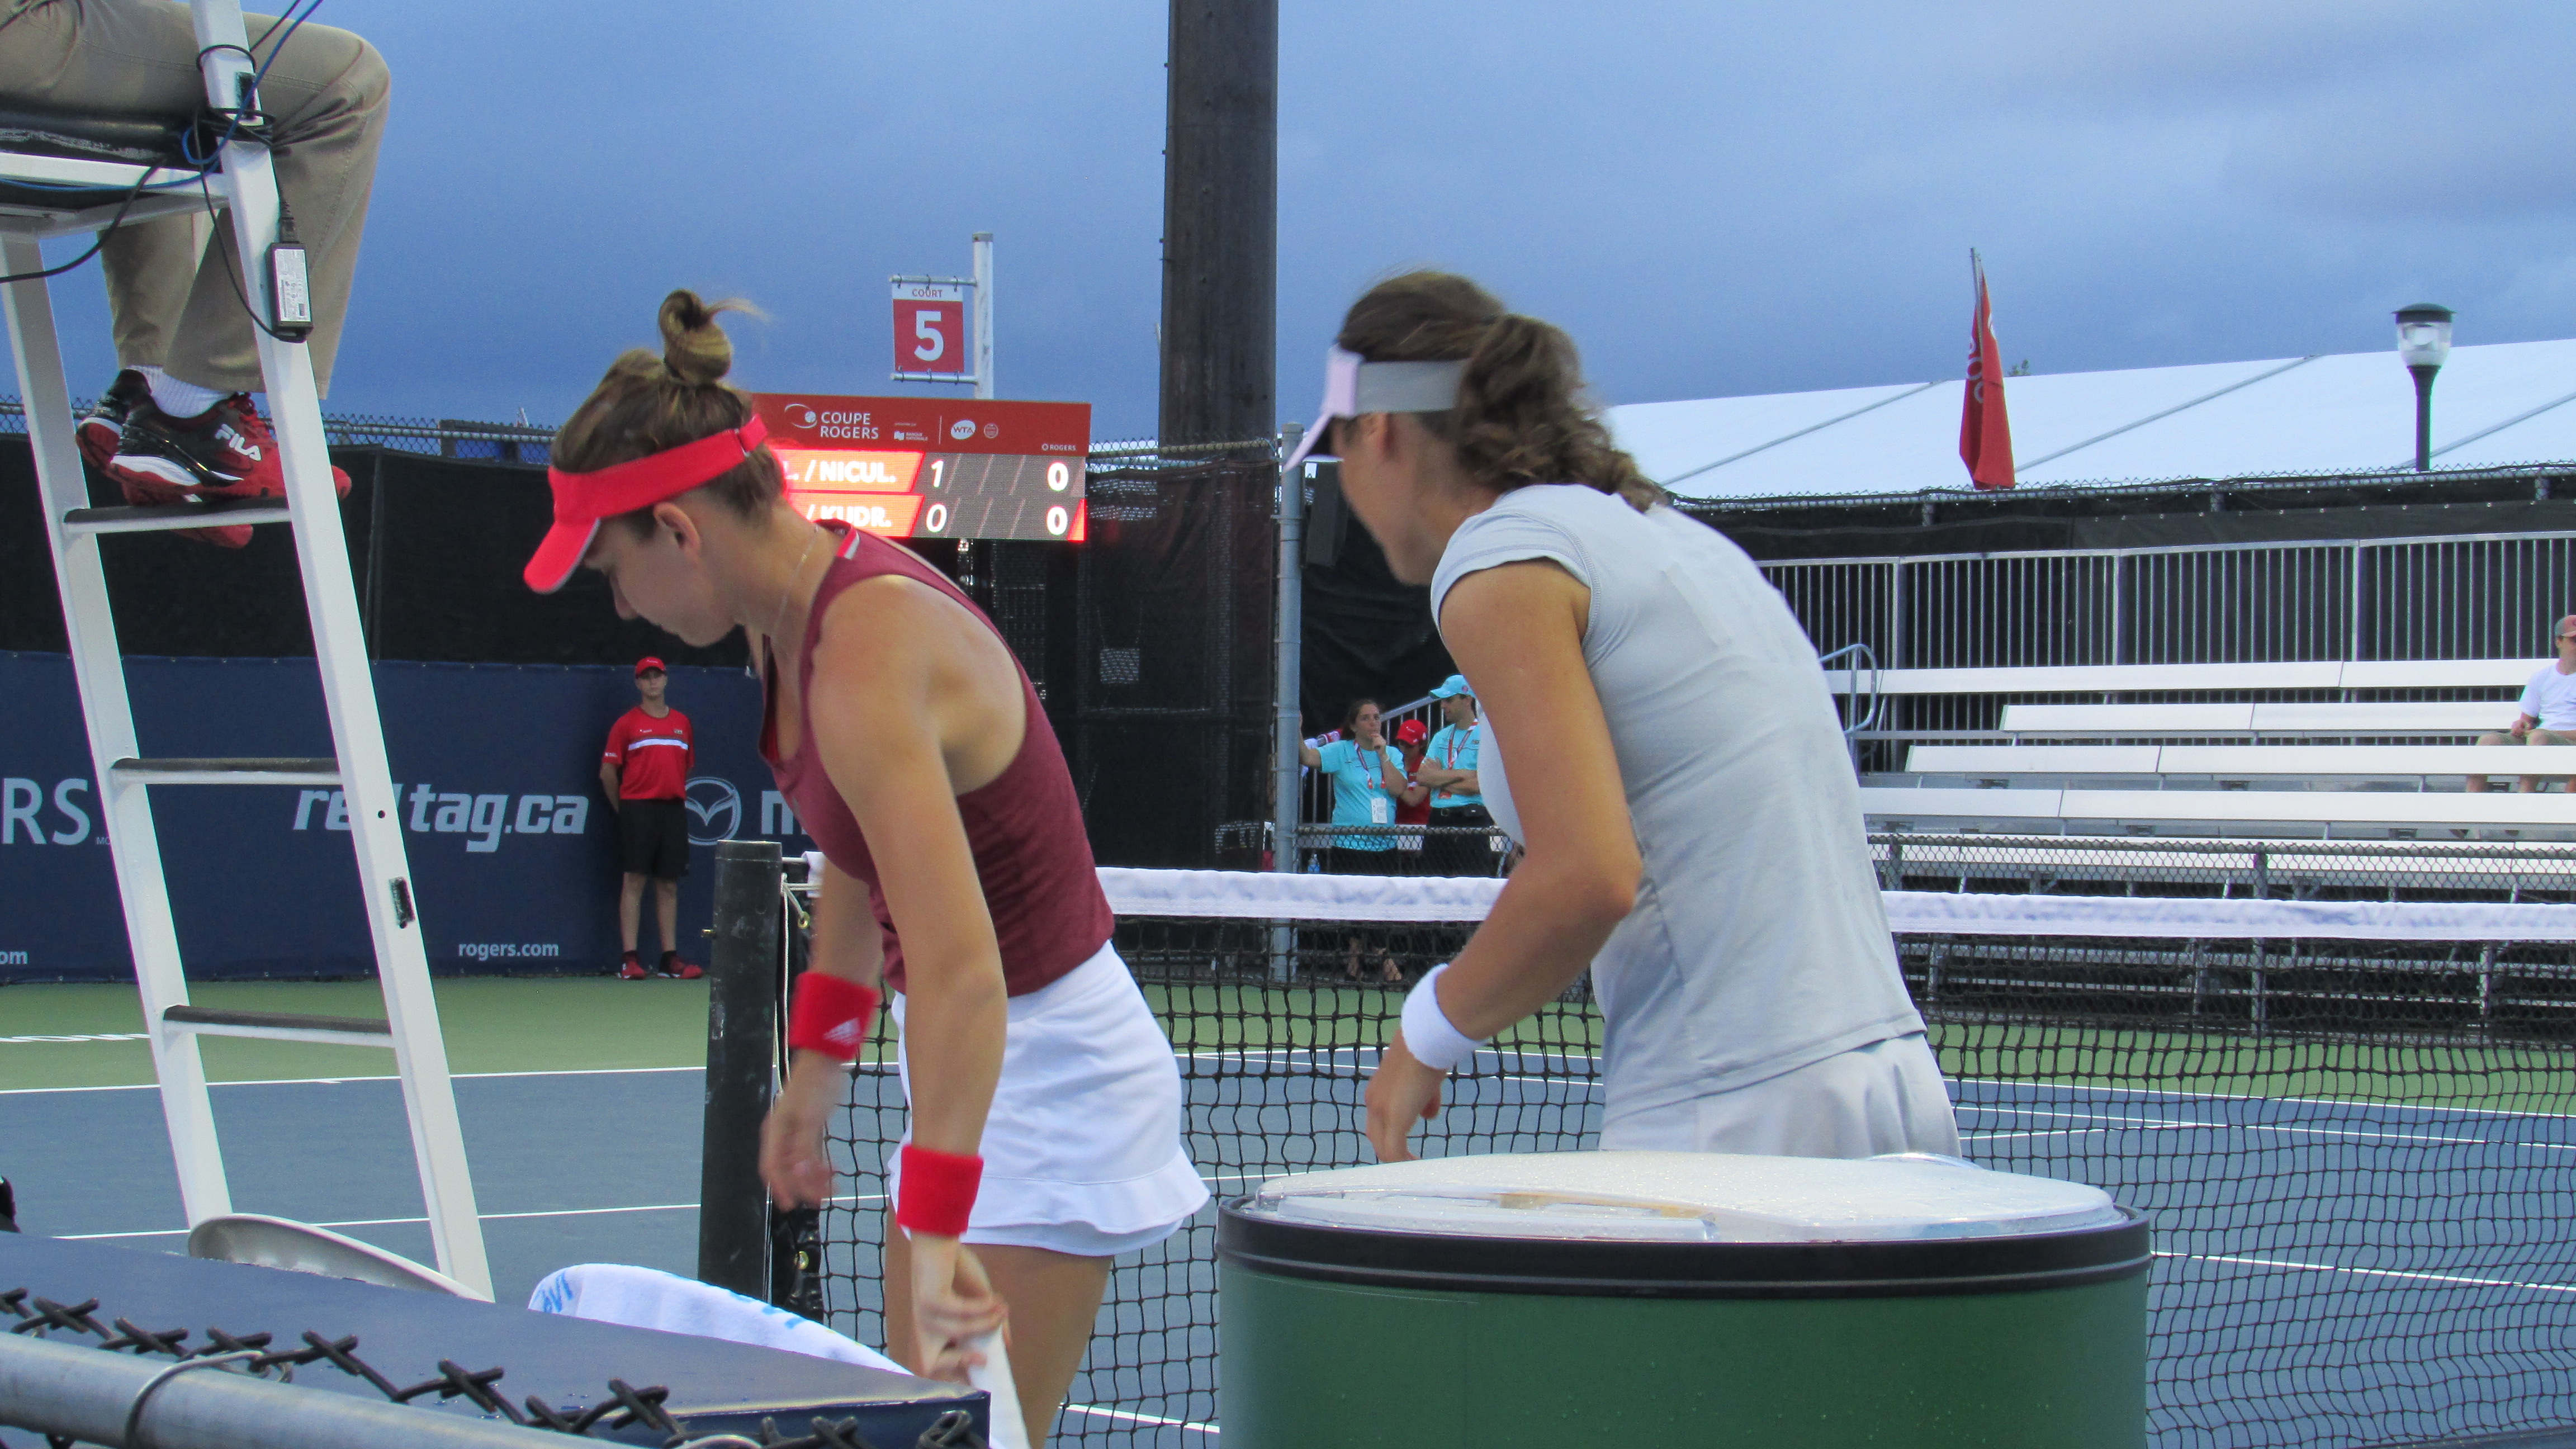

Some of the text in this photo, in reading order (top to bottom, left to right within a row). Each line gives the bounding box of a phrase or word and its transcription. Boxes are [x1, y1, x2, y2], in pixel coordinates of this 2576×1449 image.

[912, 289, 943, 297] COURT
[914, 310, 944, 361] 5
[821, 412, 871, 425] COUPE
[215, 424, 262, 461] FILA
[820, 426, 879, 439] ROGERS
[931, 460, 944, 487] 1
[1047, 462, 1069, 491] 0
[926, 503, 947, 533] 0
[1046, 506, 1068, 536] 0
[458, 943, 559, 962] rogers.com
